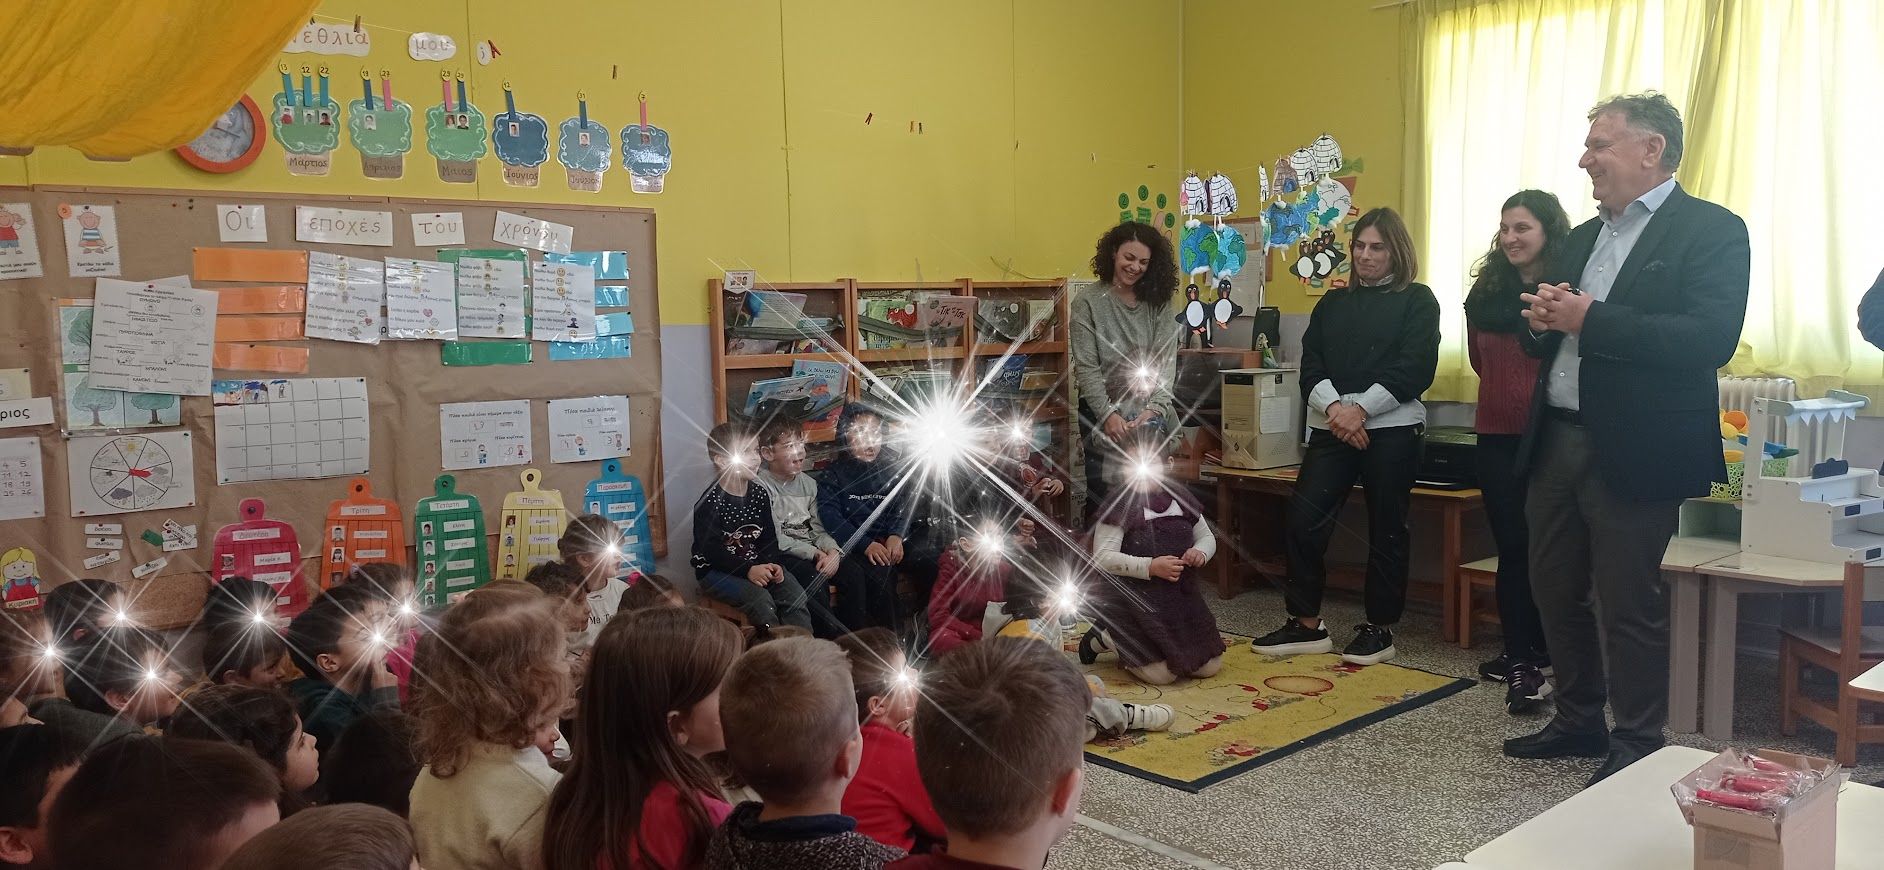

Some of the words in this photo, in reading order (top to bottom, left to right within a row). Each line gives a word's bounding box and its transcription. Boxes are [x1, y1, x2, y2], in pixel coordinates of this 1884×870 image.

[415, 39, 450, 56] μου
[320, 66, 330, 74] 22
[289, 157, 328, 171] Μάρτιος
[225, 210, 254, 231] Οι
[309, 217, 381, 236] εποχές
[418, 222, 457, 235] του
[500, 221, 558, 240] χρόνου
[522, 497, 545, 505] Πέμπτη
[351, 507, 370, 515] Τρίτη
